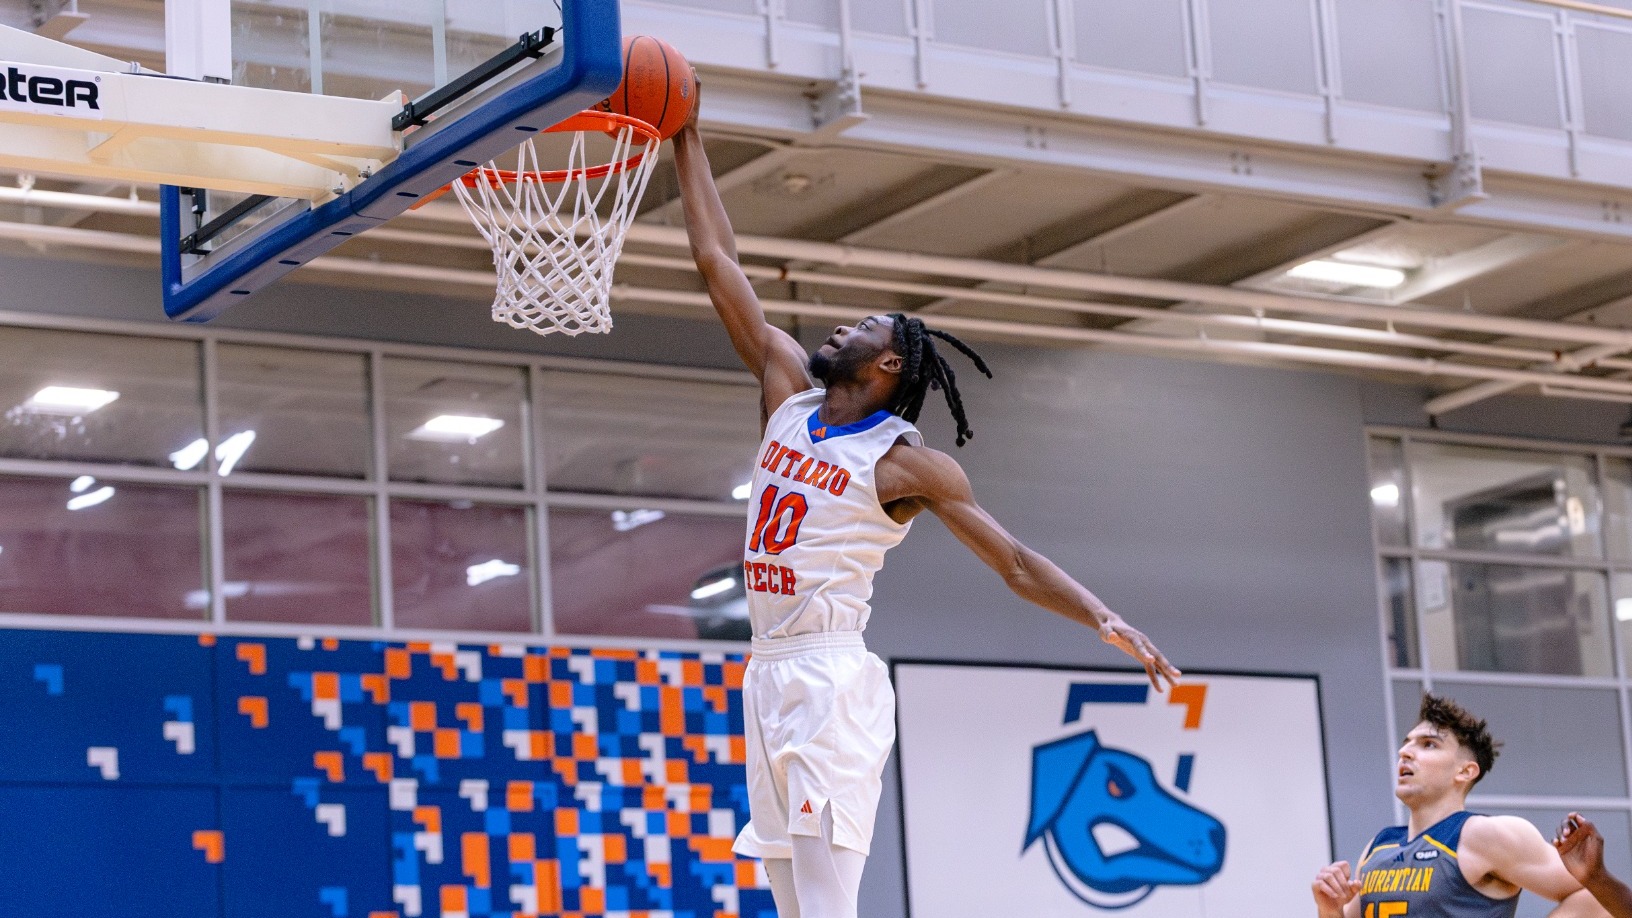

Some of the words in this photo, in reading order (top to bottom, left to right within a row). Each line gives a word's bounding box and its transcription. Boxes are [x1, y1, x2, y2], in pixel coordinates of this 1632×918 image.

[0, 67, 100, 110] teR
[749, 484, 809, 555] 10
[745, 560, 796, 595] TECH
